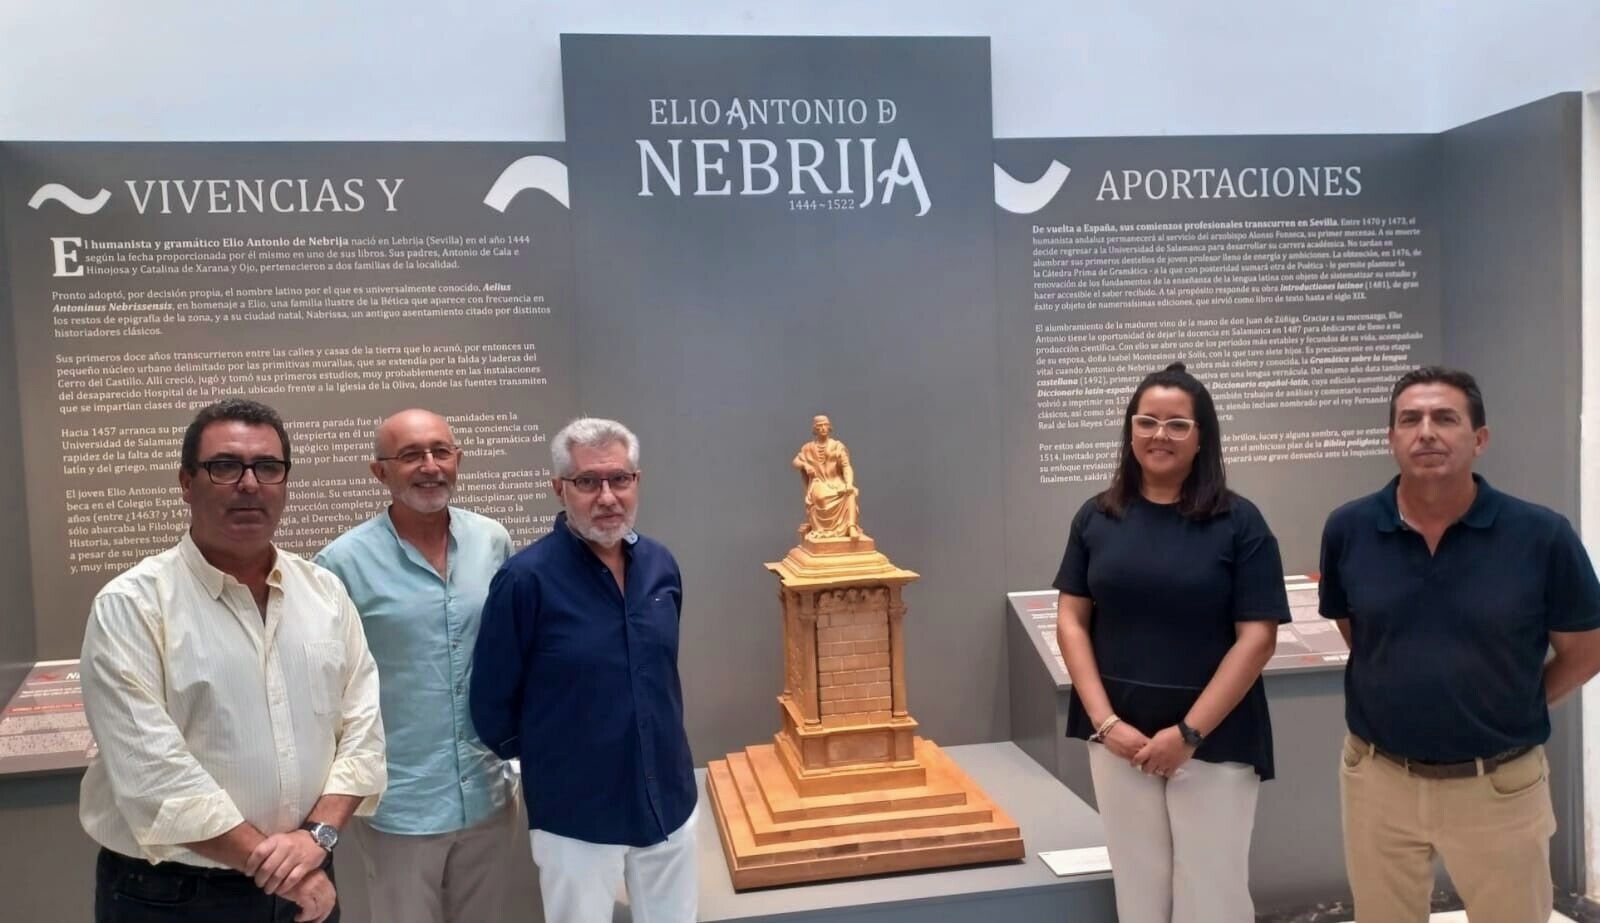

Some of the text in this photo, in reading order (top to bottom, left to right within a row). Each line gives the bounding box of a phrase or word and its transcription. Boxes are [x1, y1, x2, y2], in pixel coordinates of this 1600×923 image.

[649, 98, 721, 125] ELIO
[725, 97, 868, 130] ANTONIO
[635, 137, 932, 217] NEBRIJA
[1095, 165, 1362, 202] APORTACIONES
[124, 178, 405, 215] VIVENCIAS Y
[1032, 225, 1044, 233] De
[1046, 224, 1074, 233] vuelta
[1136, 221, 1182, 230] comienzos
[1184, 220, 1243, 231] profesionales
[1244, 218, 1296, 227] transcurren
[1381, 218, 1386, 227] y
[1409, 216, 1415, 224] el
[91, 239, 152, 249] humanista
[154, 241, 161, 250] y
[164, 238, 220, 250] gramático
[223, 238, 244, 246] Elio
[246, 237, 290, 246] Antonio
[292, 237, 305, 245] de
[309, 236, 348, 248] Nebrija
[351, 236, 376, 245] nació
[391, 235, 424, 247] Lebrija
[426, 235, 463, 246] (Sevilla)
[478, 235, 486, 243] el
[489, 235, 505, 243] año
[508, 234, 530, 243] 1444
[85, 253, 114, 265] según
[117, 252, 126, 261] la
[128, 252, 154, 261] fecha
[156, 250, 226, 263] proporcionada
[229, 252, 246, 262] por
[248, 250, 256, 259] él
[259, 249, 290, 258] mismo
[326, 249, 338, 257] de
[388, 248, 404, 257] Sus
[442, 247, 478, 256] Antonio
[480, 247, 491, 256] de
[493, 247, 512, 256] Cala
[87, 264, 130, 277] Hinojosa
[132, 266, 138, 275] y
[140, 263, 179, 273] Catalina
[182, 263, 193, 272] de
[195, 262, 229, 271] Xarana
[230, 264, 237, 273] y
[260, 261, 325, 273] pertenecieron
[335, 260, 352, 269] dos
[354, 260, 390, 269] familias
[392, 260, 404, 269] de
[405, 260, 414, 269] la
[52, 290, 86, 299] Pronto
[127, 291, 144, 300] por
[147, 288, 187, 297] decisión
[225, 287, 233, 296] el
[236, 286, 273, 296] nombre
[275, 286, 302, 295] latino
[304, 288, 321, 297] por
[323, 285, 331, 294] el
[333, 287, 351, 297] que
[366, 283, 436, 293] universalmente
[482, 282, 511, 291] Aelius
[52, 302, 106, 312] Antoninus
[190, 299, 237, 311] homenaje
[290, 297, 322, 307] familia
[324, 297, 354, 306] ilustre
[356, 296, 368, 305] de
[370, 296, 378, 305] la
[381, 296, 409, 305] Bética
[411, 298, 428, 307] que
[430, 297, 465, 306] aparece
[486, 294, 531, 303] frecuencia
[1054, 303, 1060, 312] y
[1061, 300, 1085, 311] objeto
[1087, 300, 1096, 308] de
[1098, 298, 1155, 308] numerosísimas
[1196, 298, 1209, 307] que
[1211, 296, 1232, 304] sirvió
[1255, 294, 1273, 303] libro
[1274, 294, 1284, 302] de
[1305, 293, 1324, 301] hasta
[1326, 292, 1333, 300] el
[54, 327, 120, 337] historiadores
[1109, 375, 1140, 385] primera
[1037, 388, 1082, 398] Diccionario
[1037, 399, 1061, 408] volvió
[1068, 398, 1103, 409] imprimir
[61, 427, 89, 437] Hacia
[92, 426, 116, 436] 1457
[119, 427, 156, 435] arranca
[322, 417, 372, 430] parada fue
[474, 422, 520, 433] conciencia
[293, 429, 337, 443] despierta
[352, 429, 360, 437] él
[463, 433, 545, 446] de la gramática del
[1039, 441, 1093, 451] Por estos años
